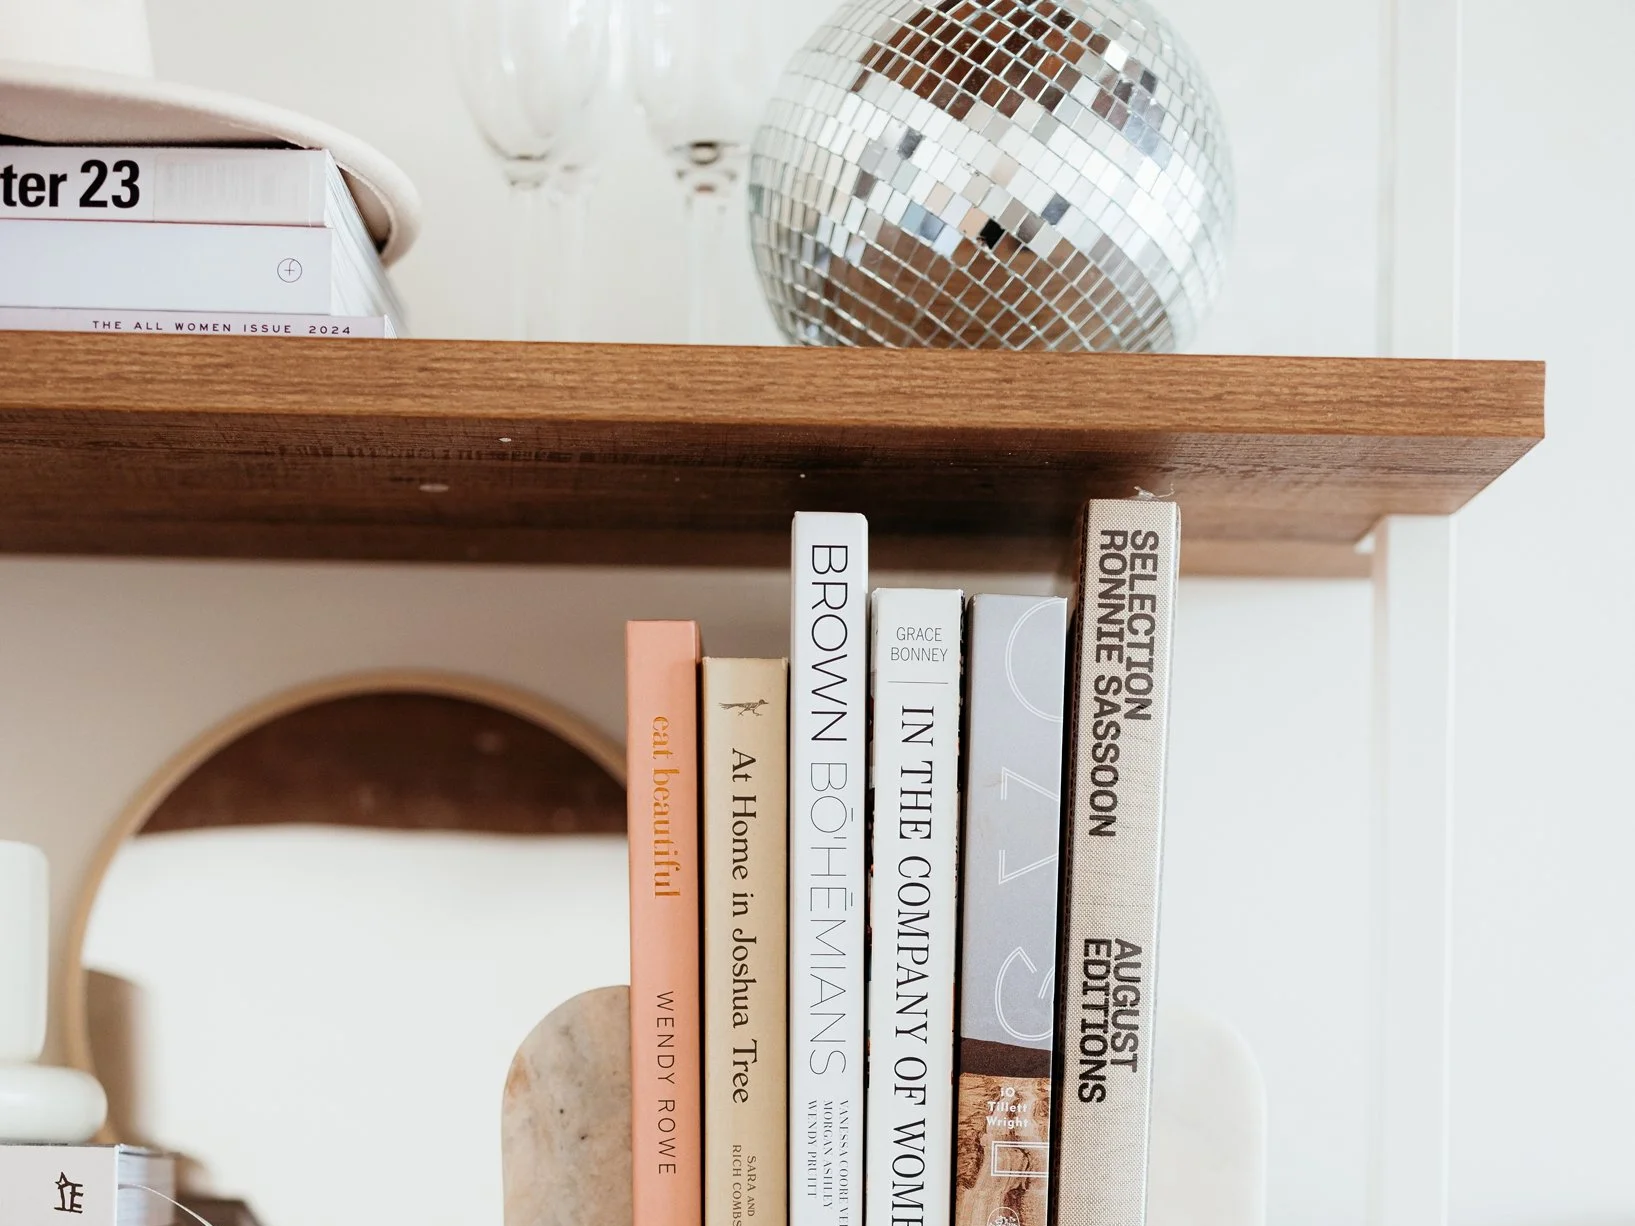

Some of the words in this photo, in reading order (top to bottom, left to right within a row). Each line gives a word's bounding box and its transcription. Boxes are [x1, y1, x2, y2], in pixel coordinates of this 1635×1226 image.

[0, 164, 67, 208] ter
[79, 160, 140, 208] 23
[93, 320, 122, 330] THE
[134, 321, 163, 331] ALL
[175, 322, 232, 332] WOMEN
[243, 324, 292, 334] ISSUE
[308, 325, 352, 335] 2024
[1095, 529, 1128, 664] RONNIE
[811, 545, 848, 742] BROWN
[896, 627, 942, 642] GRACE
[1124, 529, 1159, 721] SELECTION
[890, 647, 948, 662] BONNEY
[652, 716, 671, 760] eat
[901, 706, 934, 747] IN
[732, 748, 757, 783] At
[1089, 674, 1122, 837] SASSOON
[899, 760, 933, 840] THE
[652, 768, 681, 899] beautiful
[732, 795, 757, 880] Home
[732, 891, 754, 918] in
[895, 855, 932, 1044] COMPANY
[732, 928, 757, 1029] Joshua
[1077, 938, 1112, 1104] EDITIONS
[1109, 938, 1143, 1073] AUGUST
[656, 991, 675, 1085] WENDY
[732, 1038, 758, 1104] Tree
[893, 1056, 927, 1106] OF
[807, 1100, 818, 1146] WENDY
[823, 1100, 834, 1155] MORGAN
[839, 1100, 849, 1156] VANESSA
[986, 1116, 1029, 1129] Wright
[987, 1101, 1028, 1112] Tillett
[657, 1099, 677, 1175] ROWE
[732, 1144, 742, 1177] RICH
[746, 1155, 757, 1192] SARA
[823, 1158, 834, 1209] ASHLEY
[839, 1159, 849, 1204] COORE
[747, 1196, 756, 1217] AND
